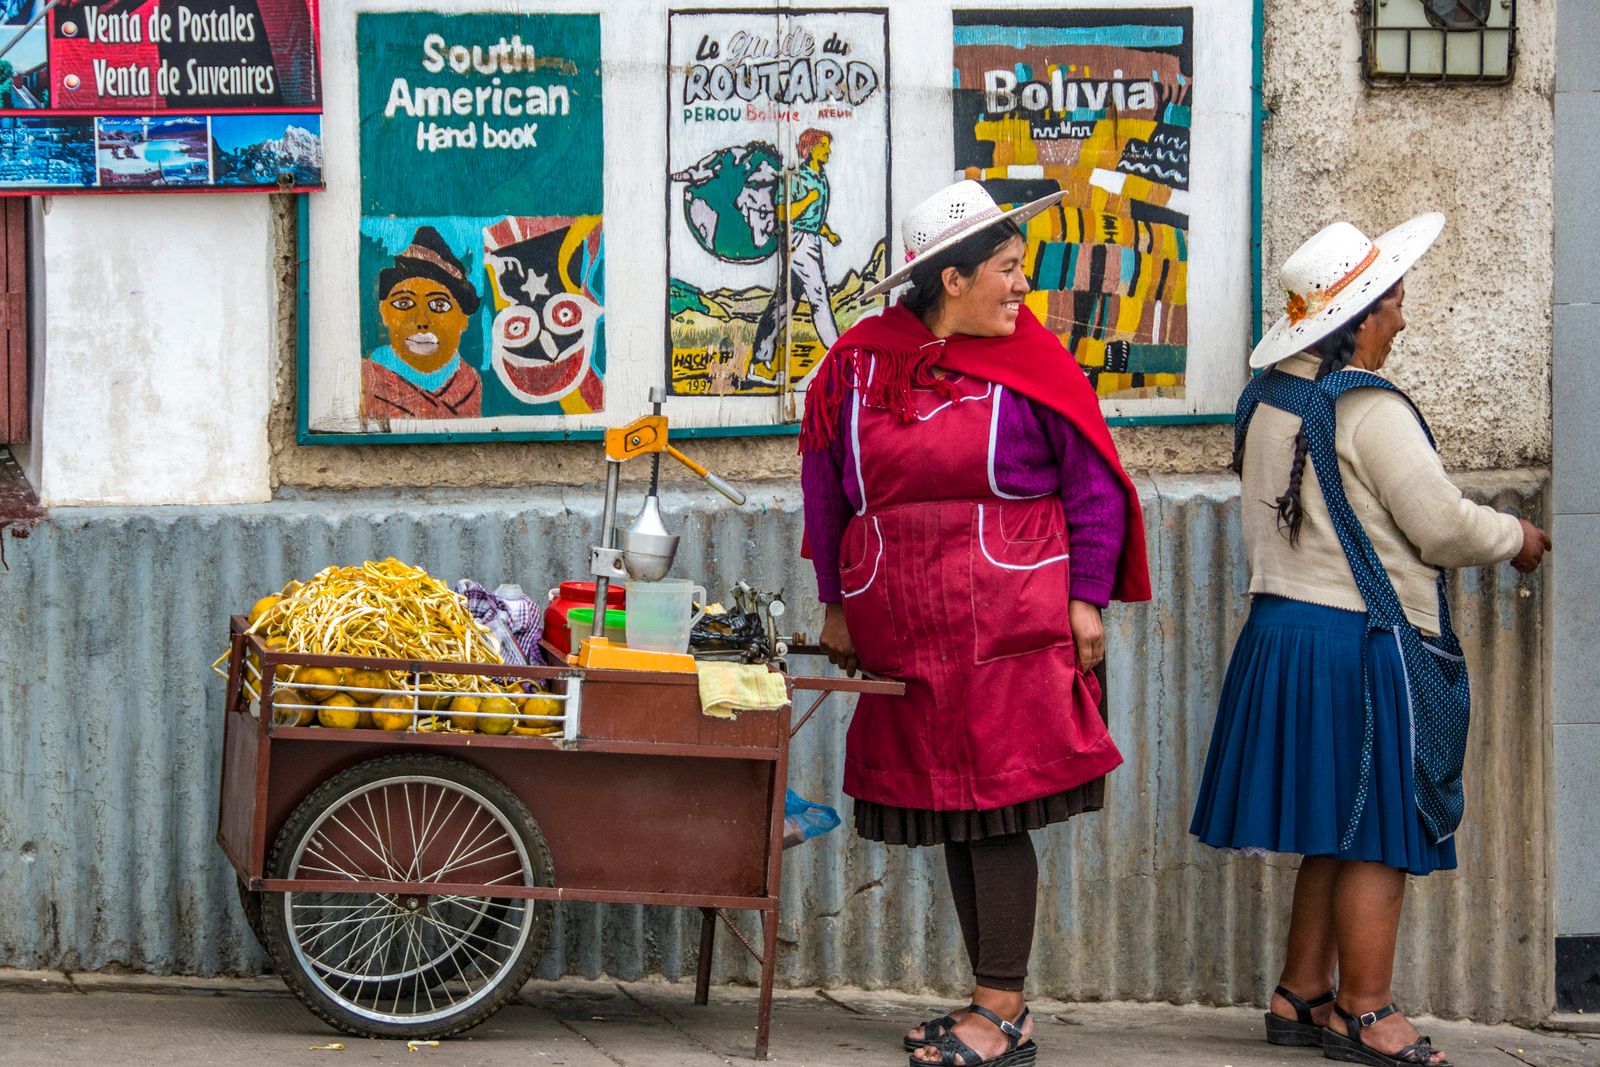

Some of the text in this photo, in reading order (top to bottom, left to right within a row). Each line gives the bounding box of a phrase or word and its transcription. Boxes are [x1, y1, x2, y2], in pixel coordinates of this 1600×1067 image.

[84, 5, 255, 42] Venta de Postales
[422, 33, 536, 75] South
[695, 34, 720, 62] Le
[823, 32, 851, 56] du
[93, 58, 274, 95] Venta de Suvenires
[683, 58, 879, 107] ROUTARD
[984, 69, 1155, 112] Bolivia
[384, 77, 570, 118] American
[683, 106, 742, 124] PEROU
[746, 103, 801, 125] Bolivie
[416, 121, 538, 152] Hand book
